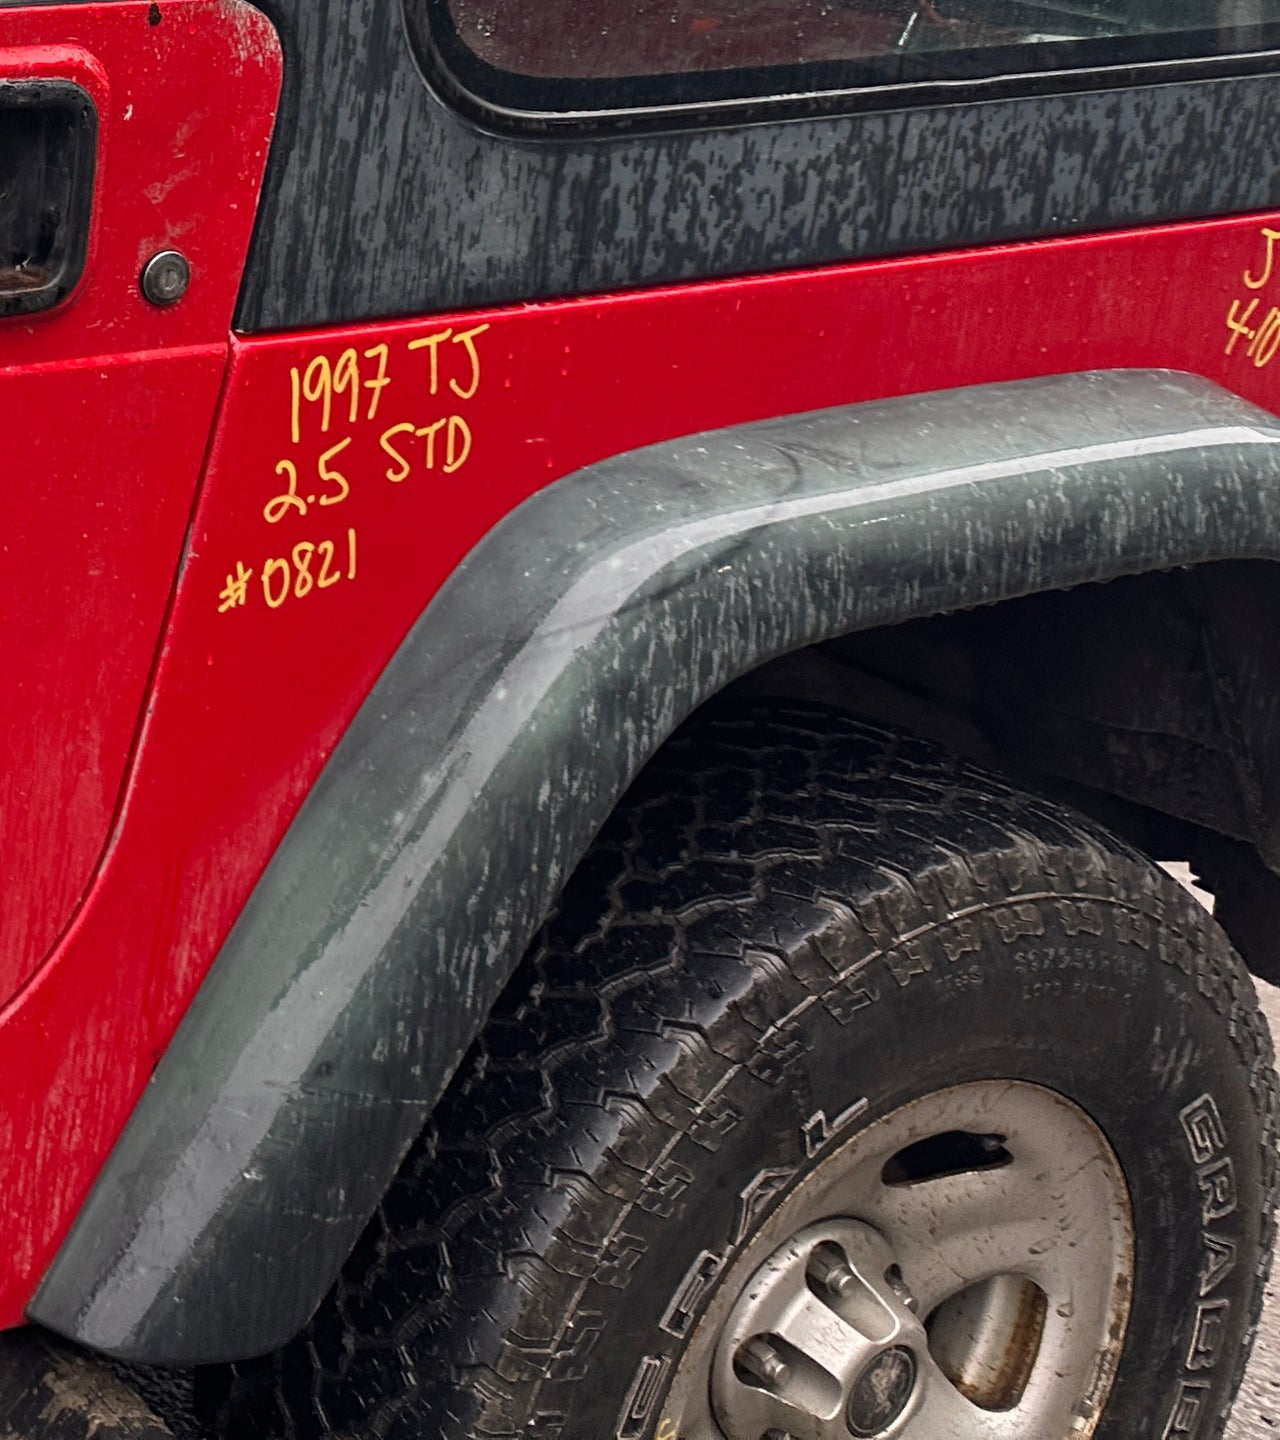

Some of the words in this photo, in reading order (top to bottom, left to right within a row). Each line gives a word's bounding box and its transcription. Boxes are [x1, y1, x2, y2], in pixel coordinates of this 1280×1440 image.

[290, 342, 391, 444] 1997
[407, 323, 490, 400] TJ
[262, 437, 352, 524] 2.5
[379, 414, 472, 483] STD
[217, 527, 357, 613] #0821
